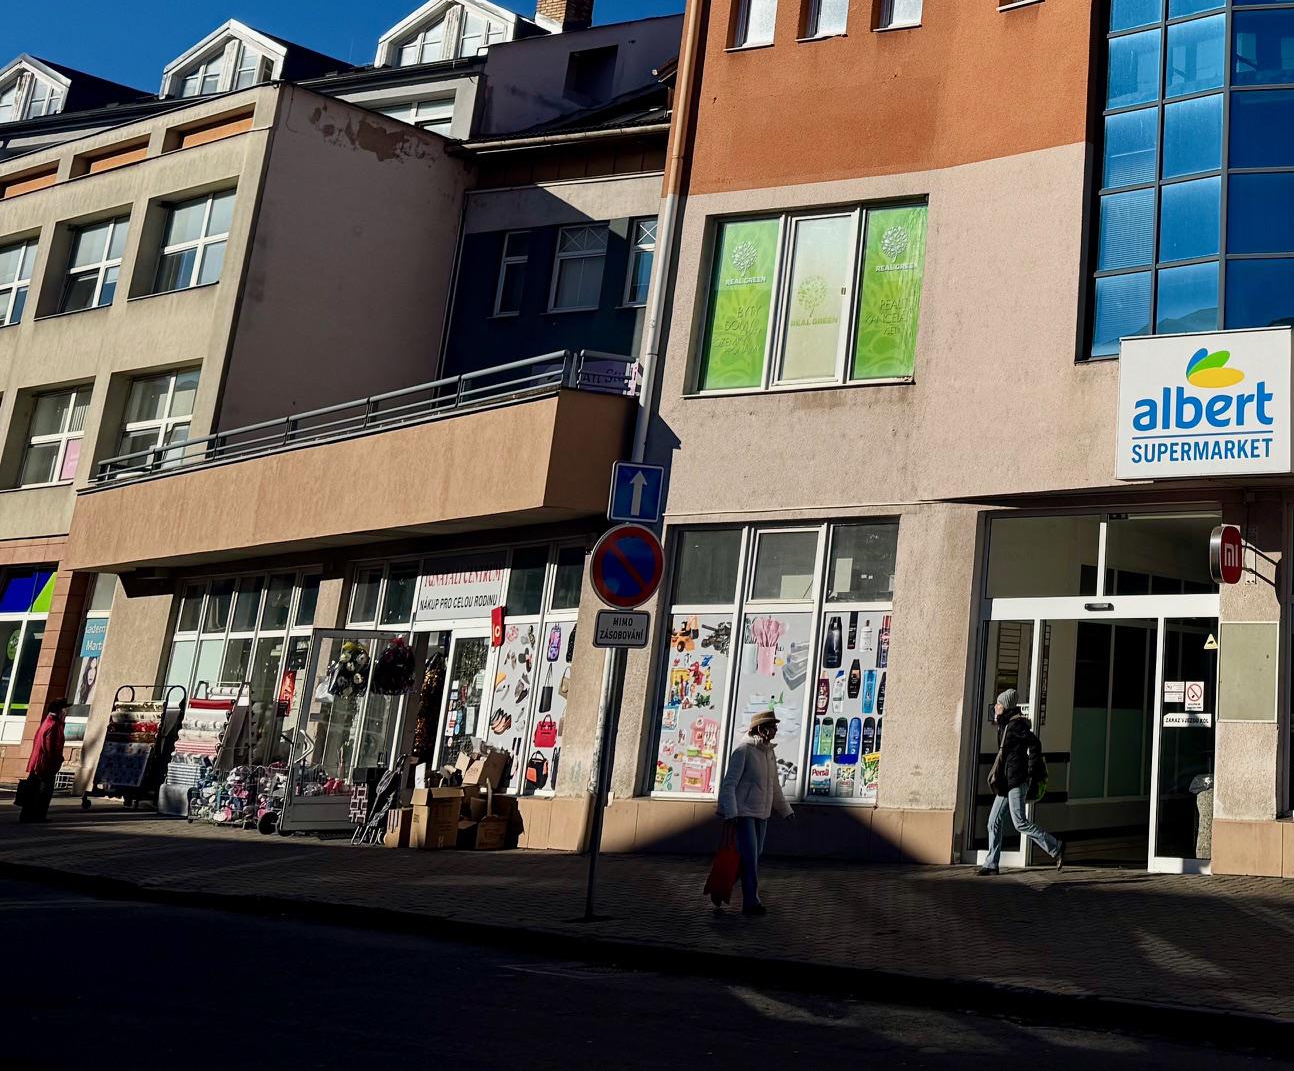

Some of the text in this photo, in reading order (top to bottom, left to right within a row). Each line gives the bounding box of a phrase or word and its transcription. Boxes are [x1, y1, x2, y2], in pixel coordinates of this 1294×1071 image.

[1132, 381, 1274, 432] albert
[1131, 438, 1273, 464] SUPERMARKET
[419, 596, 439, 611] NÁKUP
[439, 598, 452, 609] PRO
[613, 617, 633, 627] MIMO
[600, 629, 643, 640] ZÁSOBOVÁNÍ
